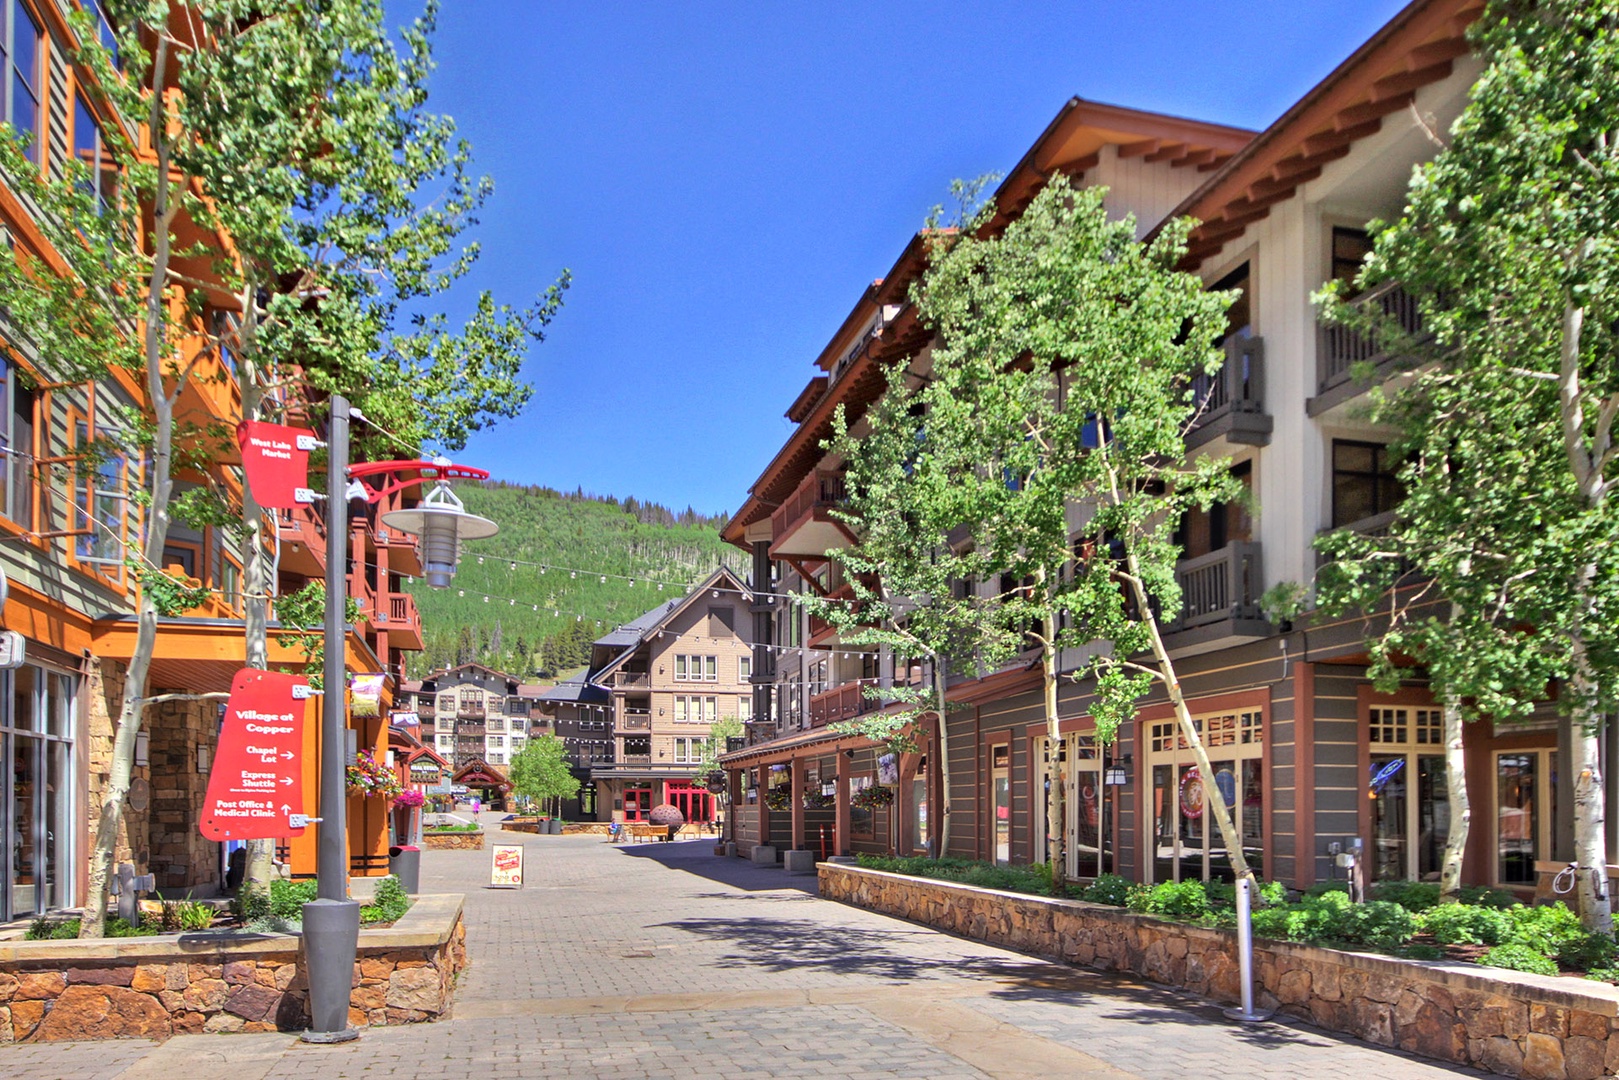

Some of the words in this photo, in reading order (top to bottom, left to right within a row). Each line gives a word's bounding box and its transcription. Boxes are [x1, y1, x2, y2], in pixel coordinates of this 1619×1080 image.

[250, 437, 271, 447] West
[272, 440, 291, 450] Lake
[262, 448, 291, 459] Market
[235, 710, 279, 722] Village
[279, 713, 294, 722] at
[246, 723, 294, 734] Copper
[246, 745, 277, 755] Chapel
[261, 755, 277, 763] Lot
[241, 770, 276, 780] Express
[242, 779, 276, 788] Shuttle
[216, 800, 237, 808] Post
[238, 800, 265, 809] Office
[266, 801, 274, 809] &
[214, 809, 249, 817] Medical
[250, 809, 276, 818] Clinic
